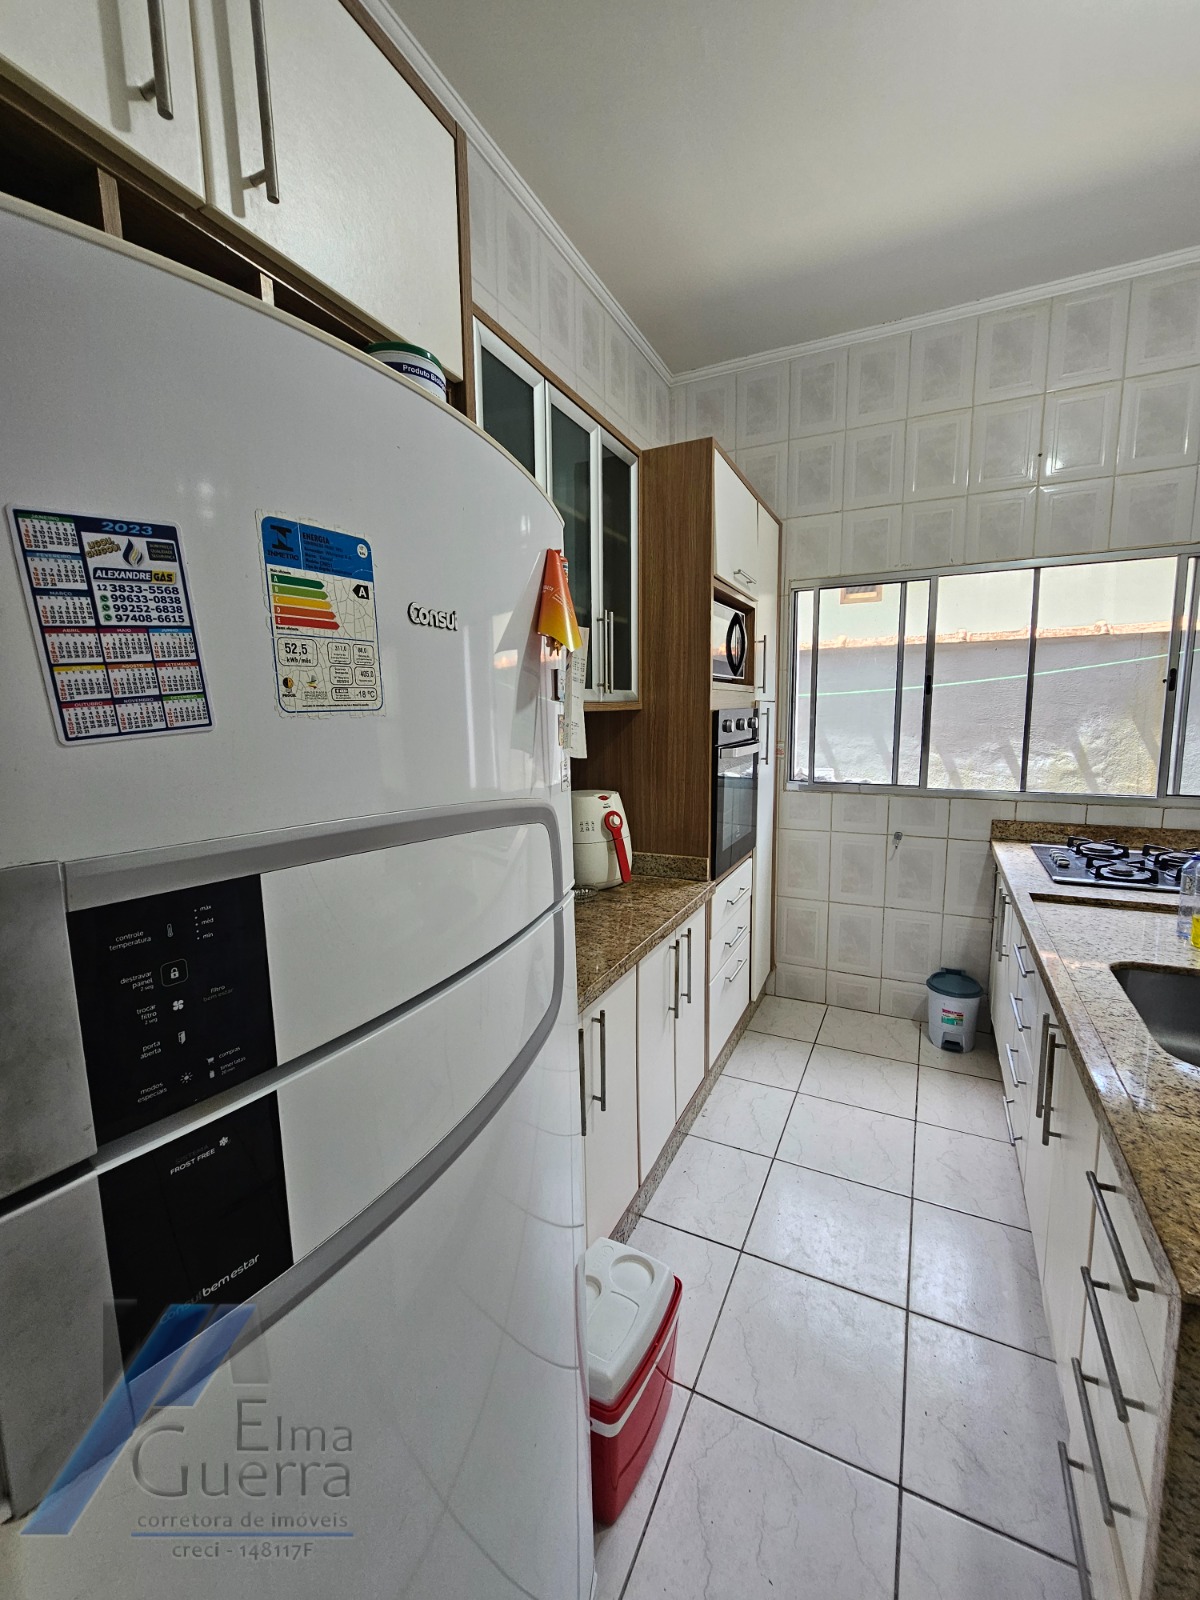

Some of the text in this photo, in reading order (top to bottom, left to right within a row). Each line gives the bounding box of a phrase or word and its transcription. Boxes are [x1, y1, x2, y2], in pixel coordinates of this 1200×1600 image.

[402, 364, 430, 379] Produto
[101, 522, 153, 535] 2023
[266, 549, 300, 561] INMETRO
[95, 570, 151, 580] ALEXANDRE
[109, 584, 179, 595] 3833-5568
[358, 587, 367, 598] A
[110, 594, 181, 605] 99633-0838
[113, 603, 183, 614] 99252-6838
[115, 614, 185, 623] 97408-6615
[407, 601, 458, 631] Consul
[284, 643, 308, 657] 52,5
[115, 931, 144, 942] controle
[109, 936, 152, 952] temperatura
[120, 971, 152, 985] destravar
[132, 977, 153, 990] painel
[136, 1004, 156, 1015] trocar
[140, 1011, 157, 1021] filtro
[142, 1041, 161, 1052] porta
[218, 1046, 241, 1059] compras
[140, 1047, 162, 1060] aberta
[137, 1087, 168, 1103] especiais
[140, 1082, 164, 1095] modos
[170, 1148, 216, 1175] FROST FREE
